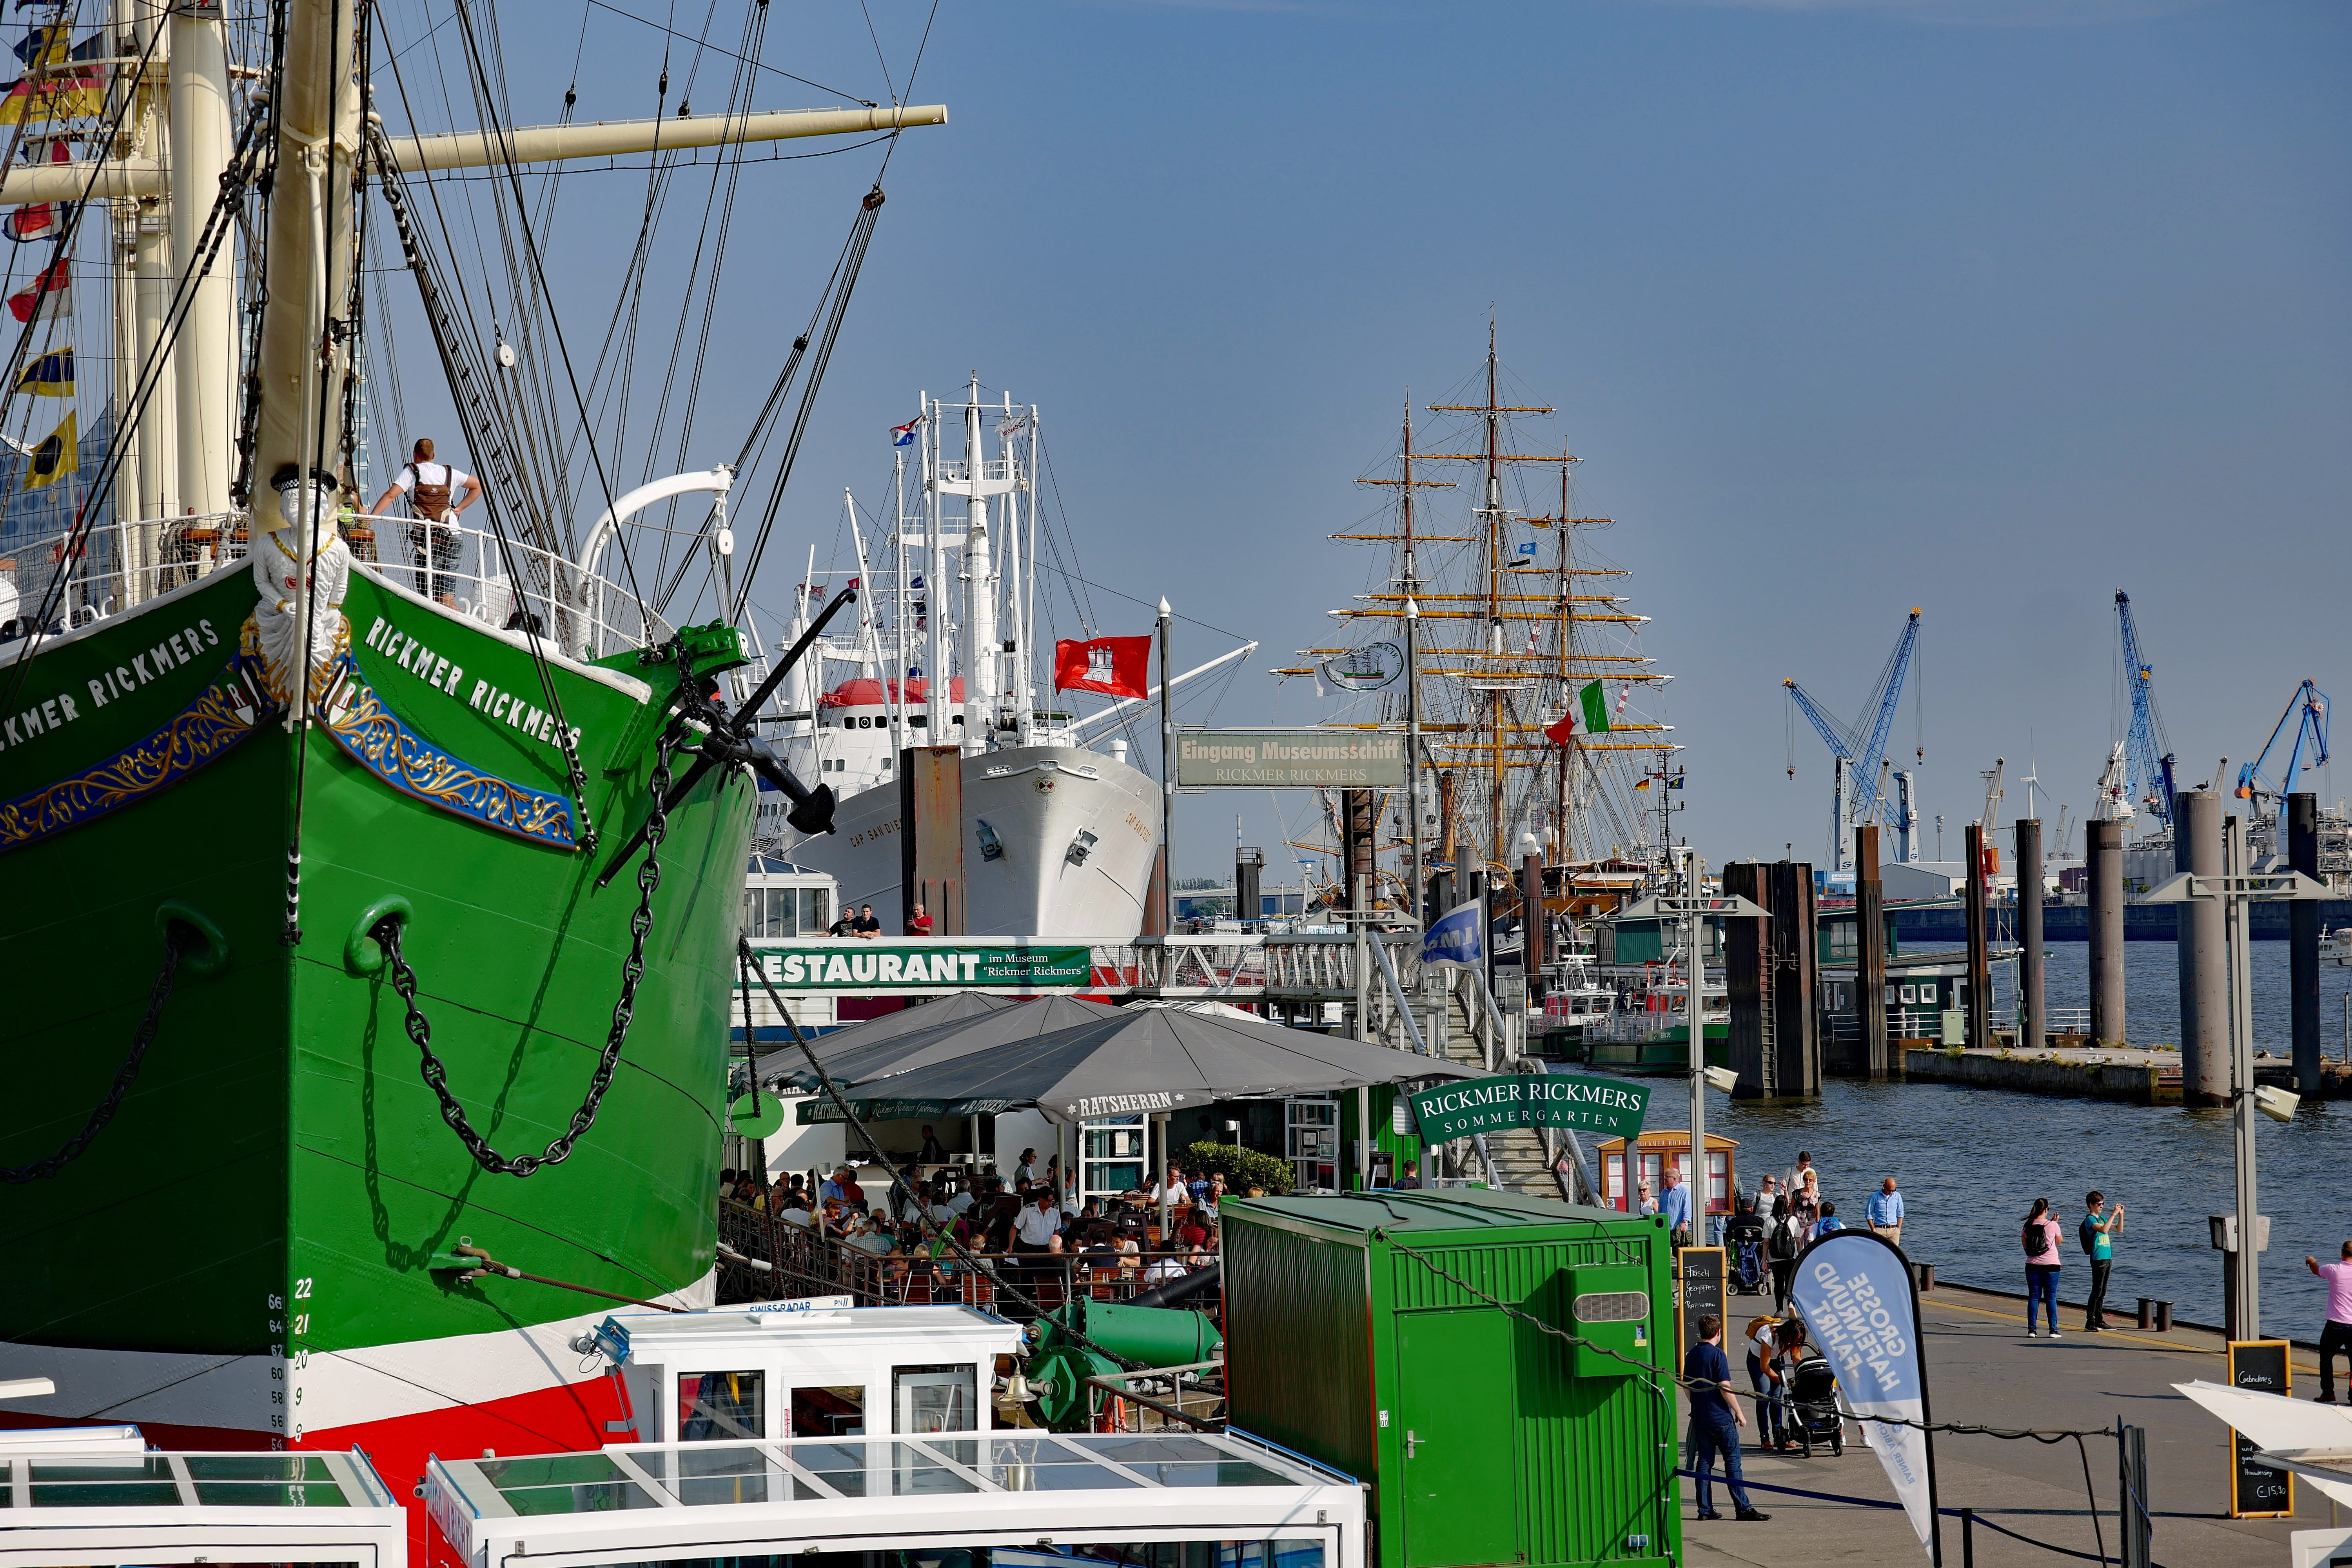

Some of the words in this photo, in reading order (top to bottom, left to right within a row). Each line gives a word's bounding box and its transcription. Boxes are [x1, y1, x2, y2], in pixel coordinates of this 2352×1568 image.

[87, 619, 219, 708] RICKMERS
[365, 616, 463, 696] RICKMER
[1181, 740, 1256, 763] Eingang
[1262, 739, 1399, 760] Museumsschiff
[1216, 769, 1285, 781] RICKMER
[1289, 769, 1367, 781] RICKMERS
[1125, 812, 1136, 826] CAP
[1134, 820, 1144, 836] SAN
[850, 834, 864, 847] CAP
[867, 826, 884, 840] SAN
[989, 954, 1002, 963] im
[1005, 955, 1049, 963] Museum
[873, 1098, 894, 1117] Rickmer
[1079, 1092, 1172, 1117] RATSHERRN
[1421, 1084, 1523, 1118] RICKMER
[1528, 1083, 1641, 1111] RICKMERS
[1445, 1110, 1618, 1133] SOMMERGARTEN
[295, 1278, 312, 1299] 22
[268, 1293, 282, 1310] 66
[269, 1319, 282, 1333] 64
[295, 1314, 309, 1334] 21
[271, 1344, 283, 1356] 62
[295, 1349, 309, 1370] 20
[271, 1367, 283, 1380] 60
[271, 1391, 283, 1404] 58
[295, 1387, 302, 1406] 9
[271, 1415, 283, 1427] 56
[271, 1438, 283, 1451] 54
[427, 1472, 444, 1524] HUGO
[447, 1500, 471, 1563] ABICHT
